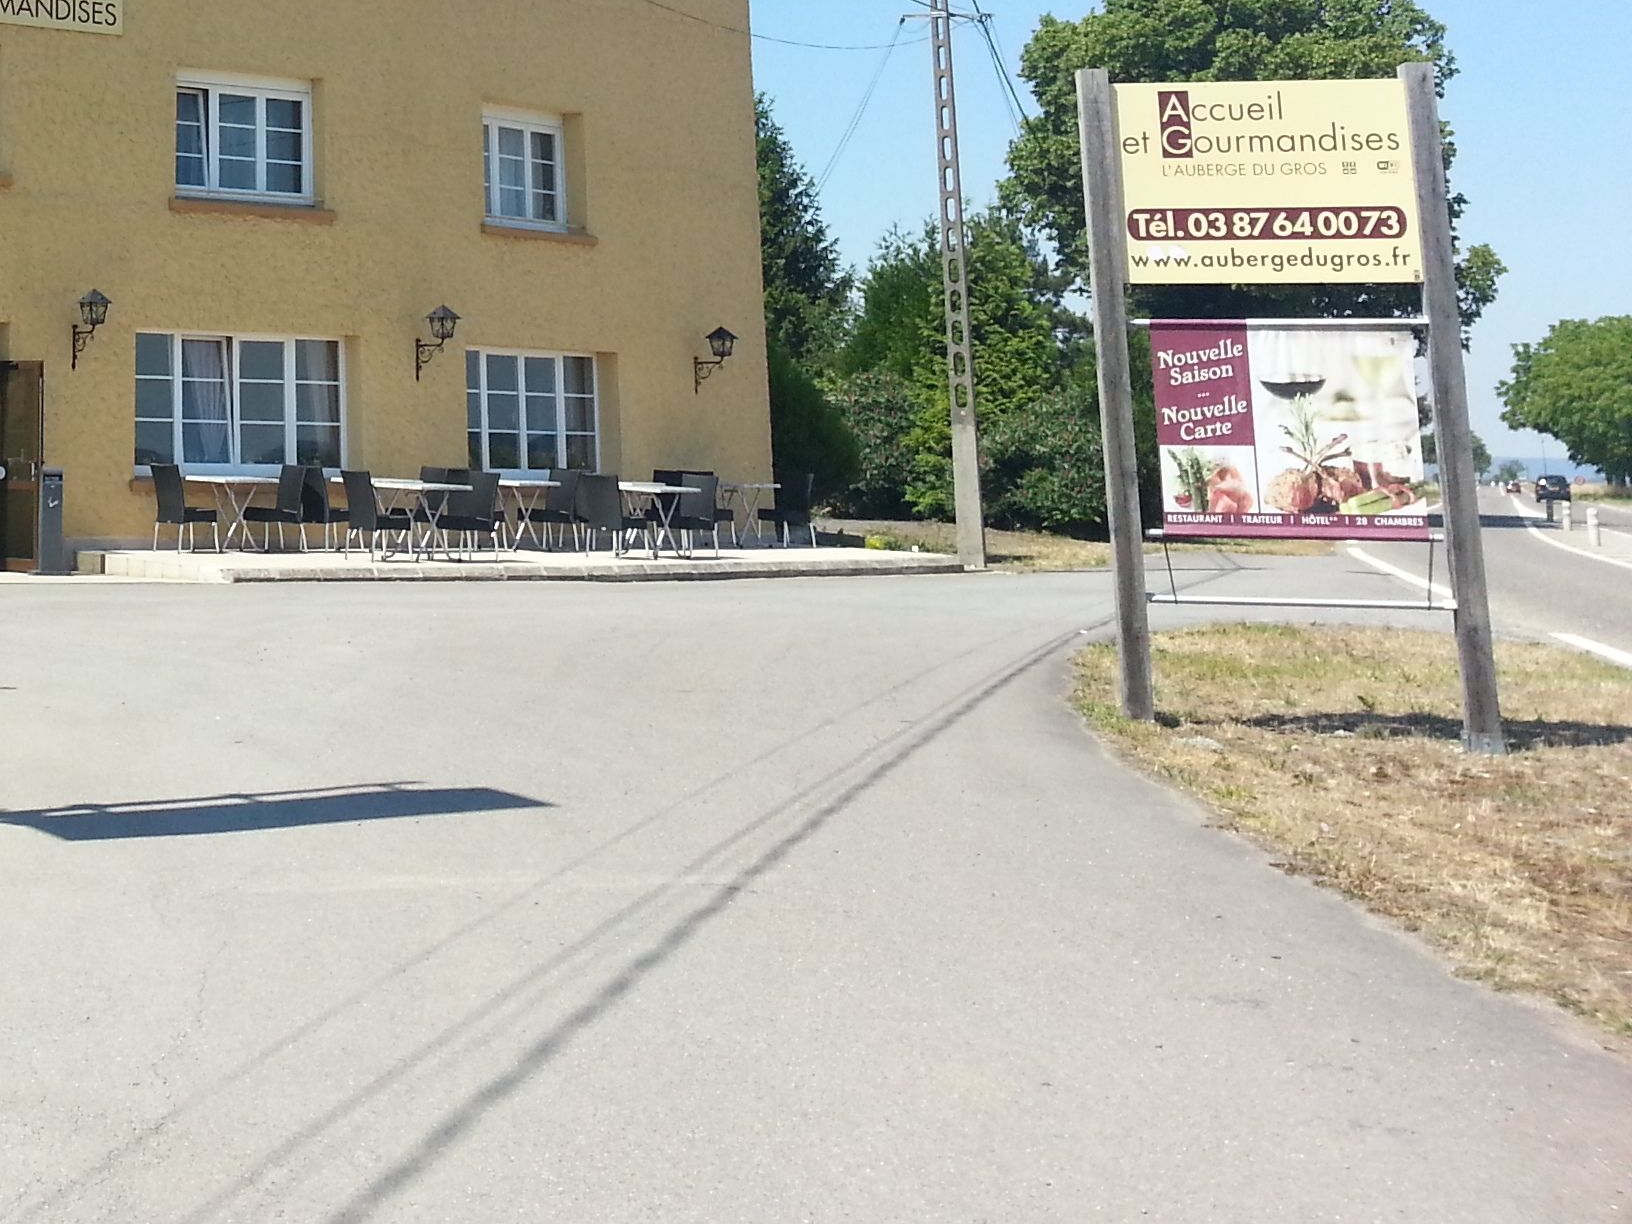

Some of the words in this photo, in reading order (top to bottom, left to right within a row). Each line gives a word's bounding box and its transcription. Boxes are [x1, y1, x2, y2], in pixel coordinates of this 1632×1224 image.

[1162, 90, 1283, 122] Accueil
[1122, 131, 1150, 155] et
[1162, 122, 1400, 155] Gourmandises
[1162, 162, 1246, 176] L'AUBERGE
[1252, 163, 1275, 176] DU
[1280, 162, 1327, 176] GROS
[1131, 245, 1411, 273] www.aubergedugros.fr
[1157, 338, 1243, 369] Nouvelle
[1170, 364, 1234, 386] Saison
[1161, 395, 1248, 425] Nouvelle
[1180, 421, 1233, 441] Carte
[1167, 515, 1223, 524] RESTAURANT
[1374, 516, 1424, 526] CHAMBRES
